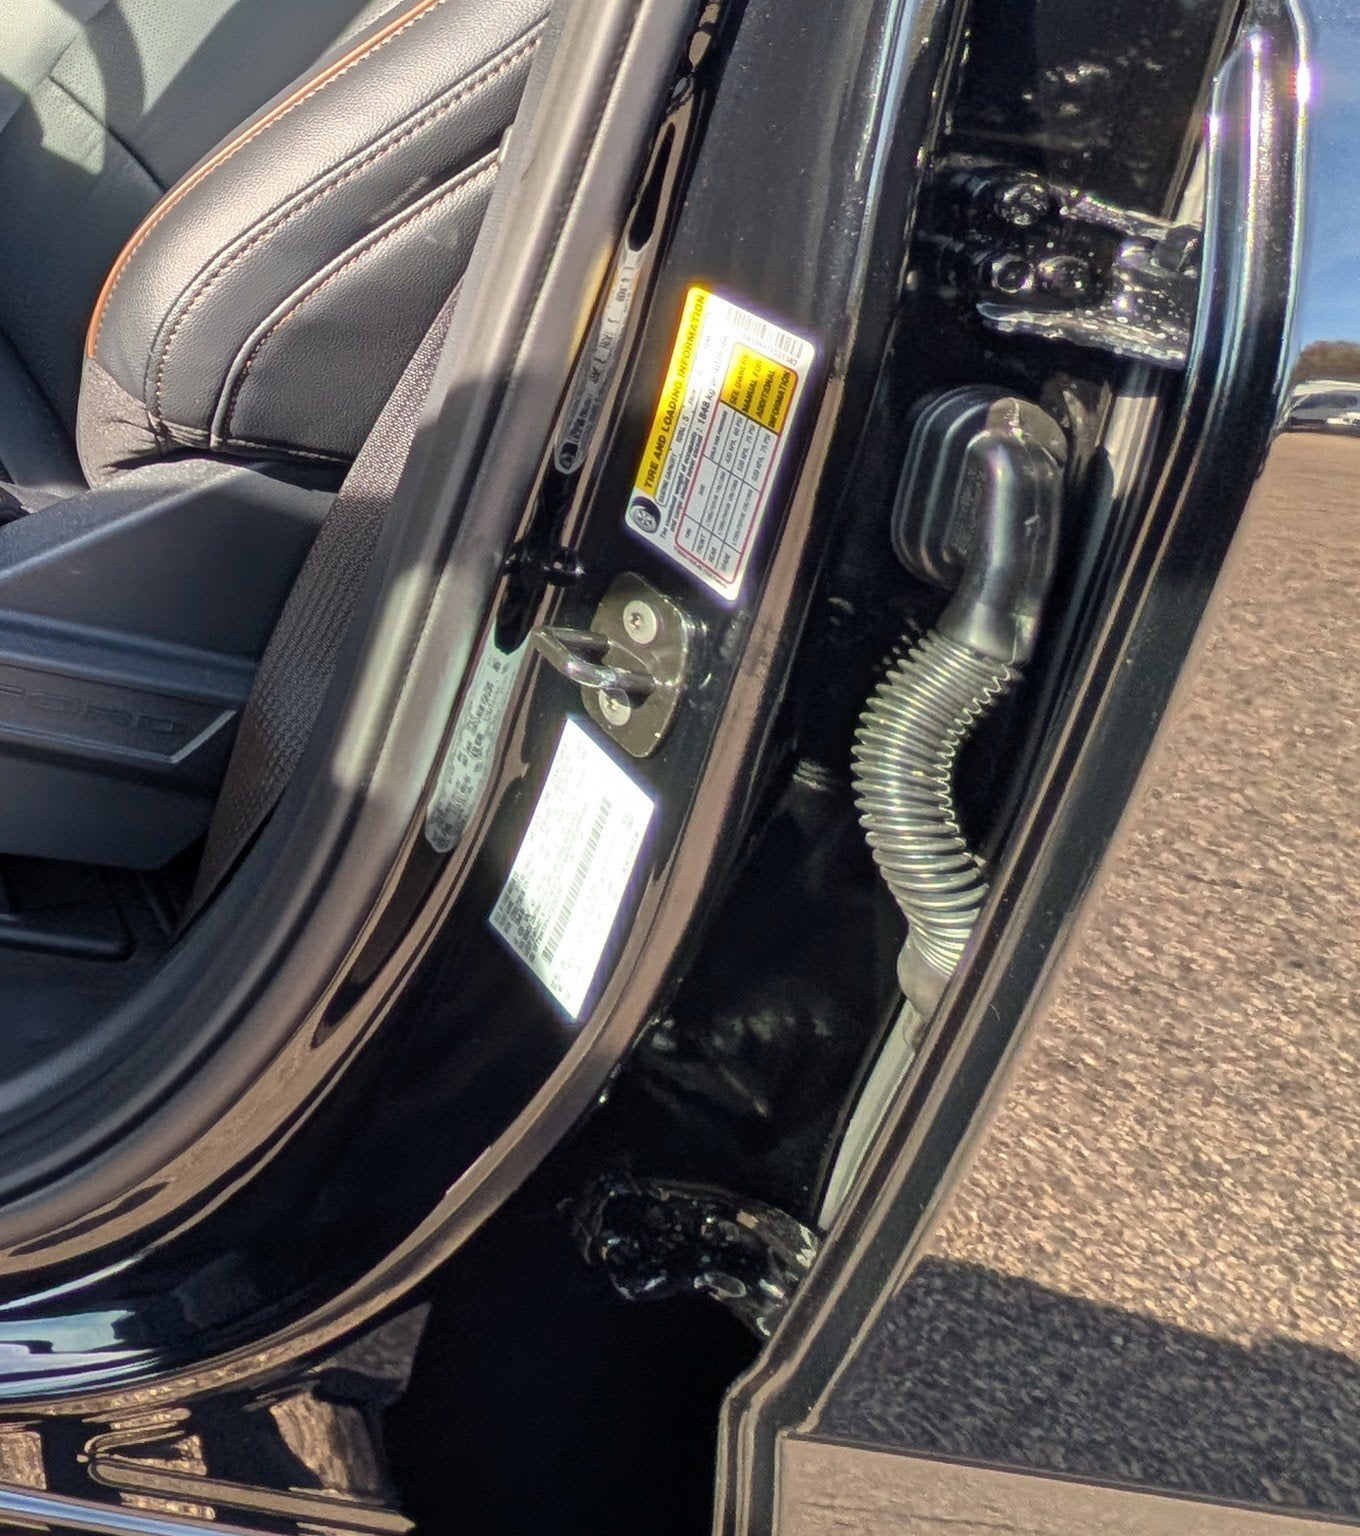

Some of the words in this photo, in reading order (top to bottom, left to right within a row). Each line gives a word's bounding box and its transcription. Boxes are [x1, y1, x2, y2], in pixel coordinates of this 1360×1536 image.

[646, 459, 659, 491] TIRE
[655, 432, 667, 461] AND
[663, 378, 682, 434] LOADING
[681, 293, 705, 378] INFORMATION
[696, 399, 710, 426] 1848
[704, 387, 716, 402] kg
[728, 387, 739, 405] SEE
[740, 377, 757, 413] MANUAL
[751, 358, 763, 377] FOR
[754, 367, 776, 419] ADDITIONAL
[766, 369, 791, 428] INFORMATION
